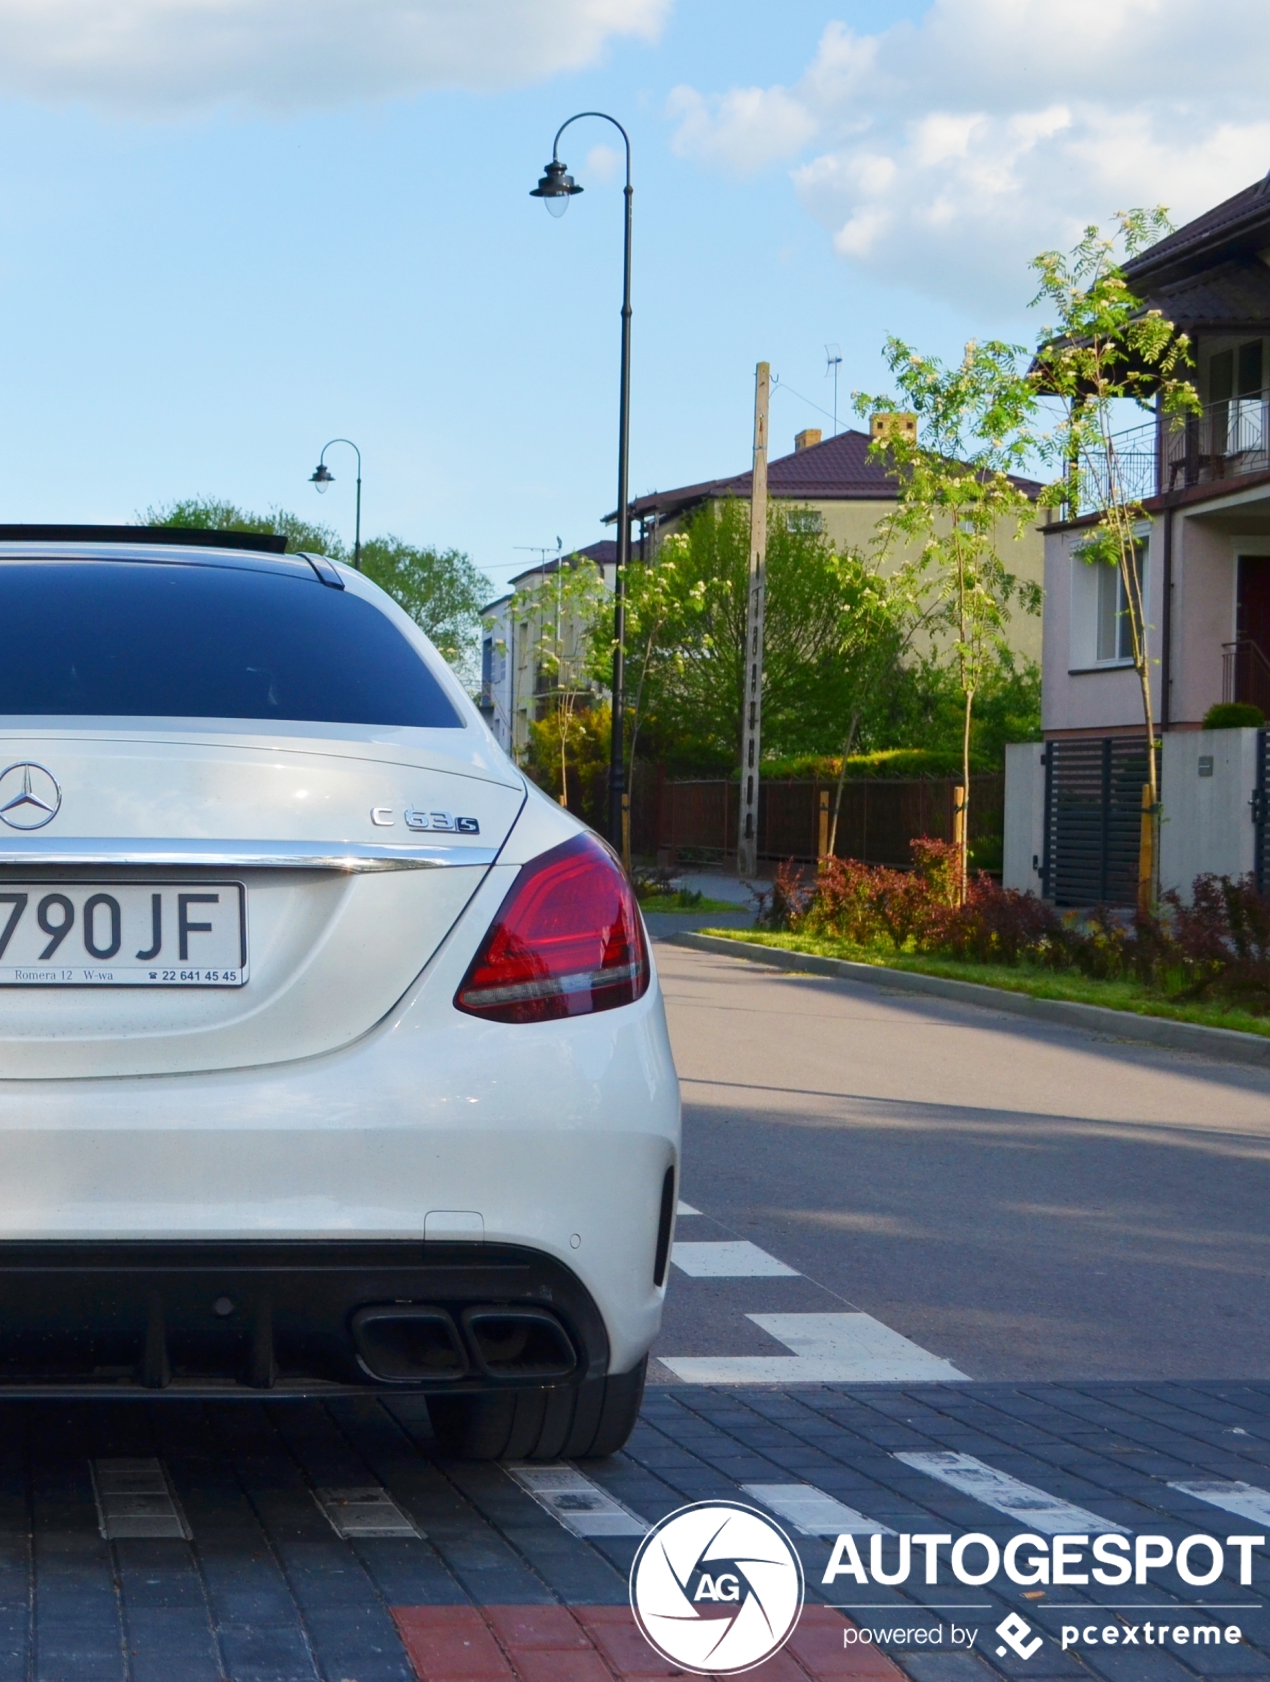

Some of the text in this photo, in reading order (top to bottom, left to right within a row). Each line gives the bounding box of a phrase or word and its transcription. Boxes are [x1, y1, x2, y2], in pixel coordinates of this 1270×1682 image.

[370, 807, 395, 826] C
[15, 970, 56, 980] Romera
[61, 970, 73, 980] 12
[84, 970, 113, 980] W-wa
[162, 971, 176, 981] 22
[180, 971, 201, 981] 641
[204, 971, 219, 981] 45
[222, 971, 237, 981] 45
